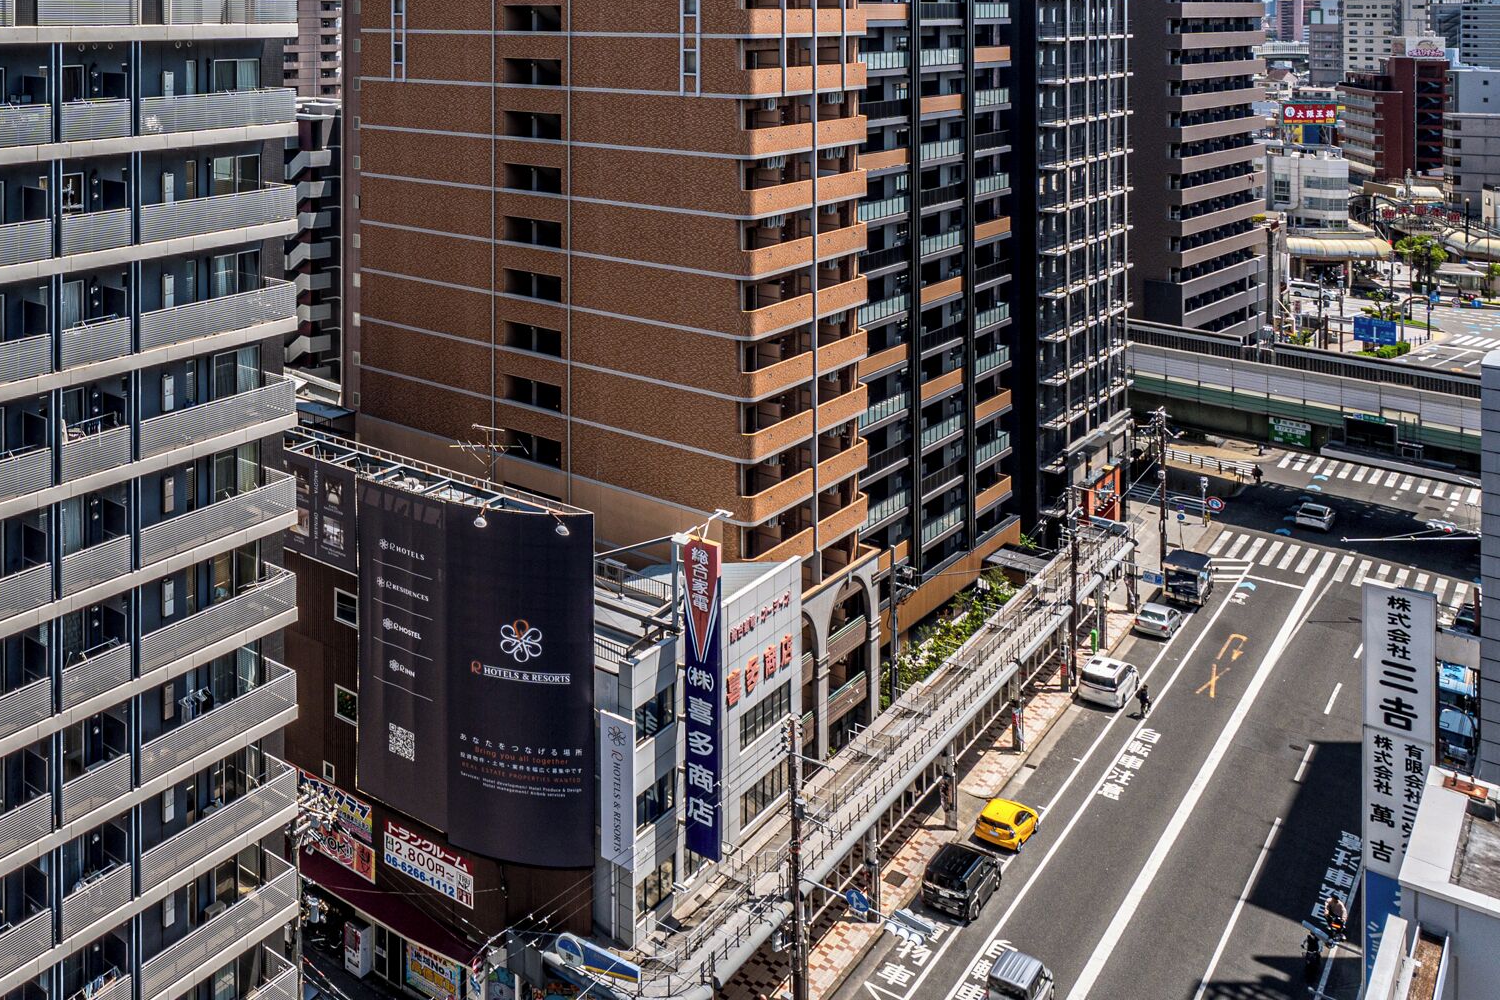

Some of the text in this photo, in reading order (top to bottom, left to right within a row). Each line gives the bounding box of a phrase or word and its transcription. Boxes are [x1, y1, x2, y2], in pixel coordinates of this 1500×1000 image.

[396, 545, 425, 561] HOTELS
[392, 583, 429, 602] RESIDENCES
[691, 546, 710, 613] 総合家電
[399, 625, 422, 640] HOSTEL
[405, 667, 415, 678] INN
[484, 666, 520, 680] HOTELS
[522, 673, 530, 681] &
[531, 674, 571, 683] RESORTS
[726, 633, 793, 708] 喜多商店
[474, 746, 497, 758] Bring
[500, 752, 516, 761] you
[532, 757, 568, 765] together
[1097, 728, 1162, 801] 自転車注意
[481, 765, 505, 778] ESTATE
[612, 761, 621, 800] HOTELS
[613, 811, 622, 853] RESORTS
[387, 821, 469, 873] トランクルーム
[385, 853, 455, 898] 06-6266-1112
